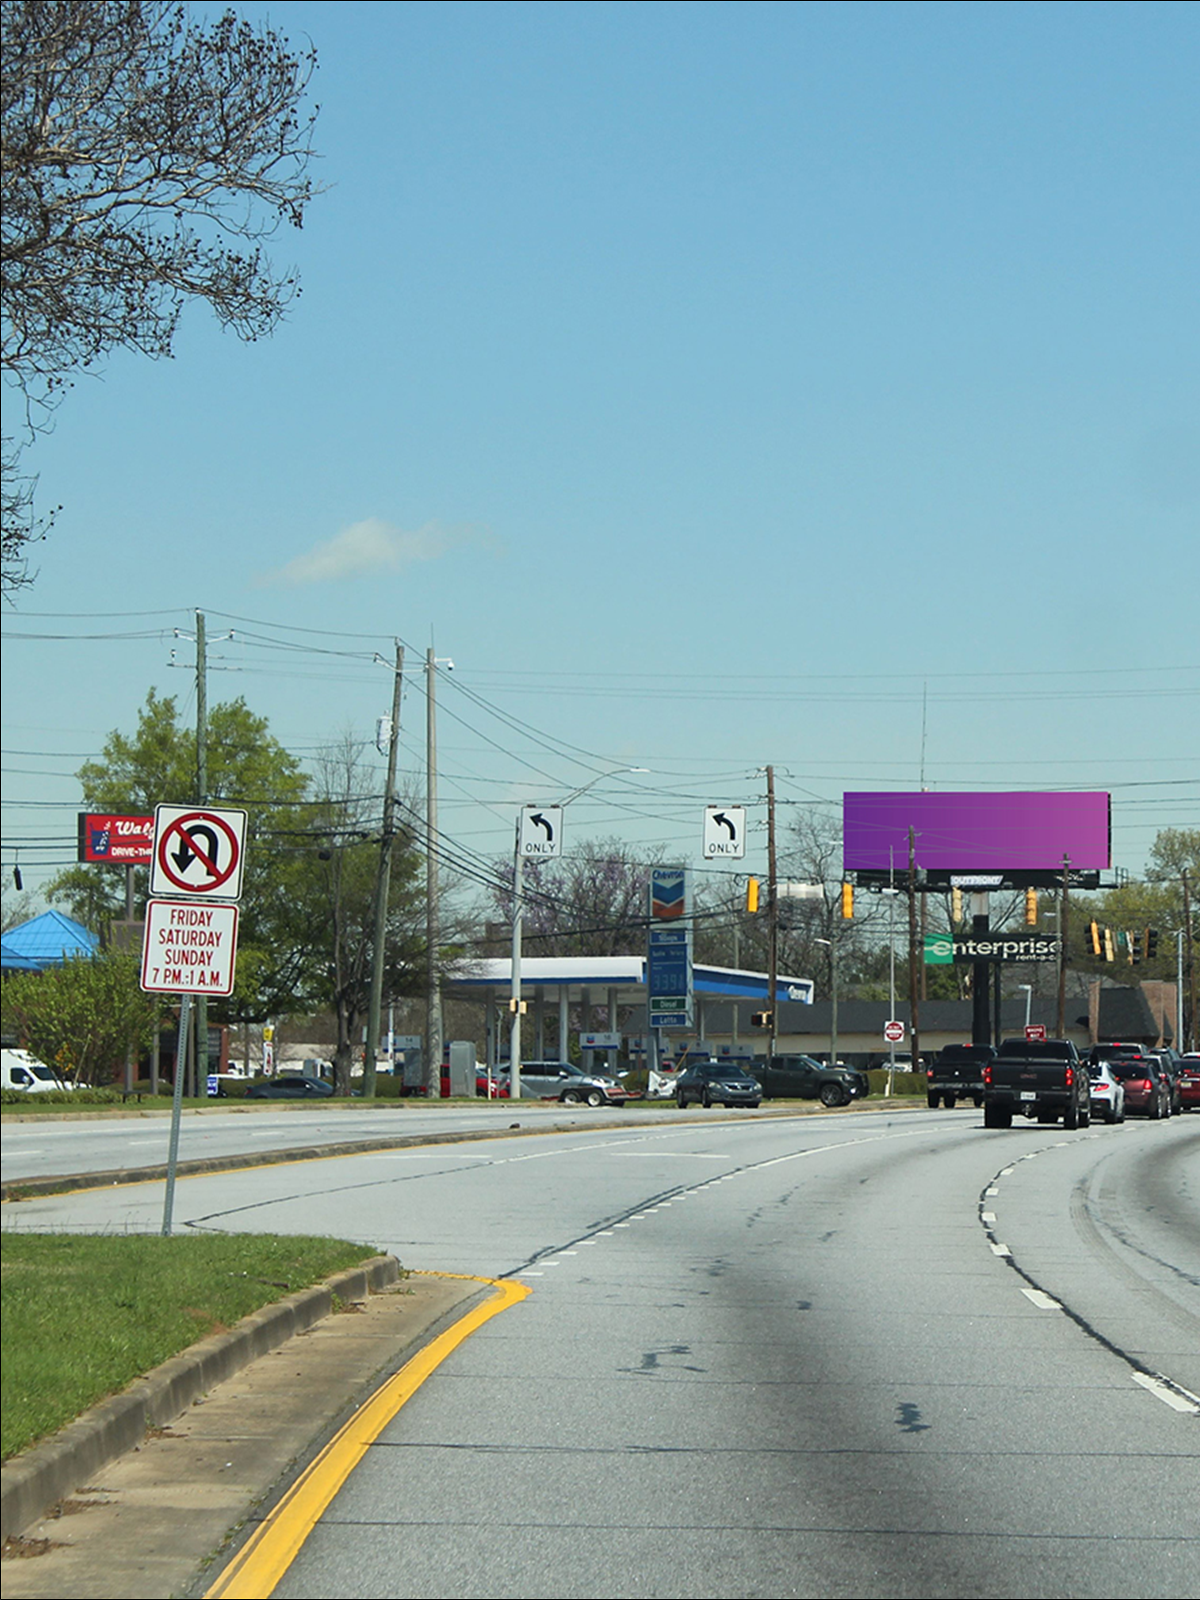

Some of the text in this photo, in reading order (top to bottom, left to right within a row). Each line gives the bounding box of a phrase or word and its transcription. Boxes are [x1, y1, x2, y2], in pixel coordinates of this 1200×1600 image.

[525, 843, 556, 853] ONLY
[708, 843, 739, 853] ONLY
[652, 869, 685, 880] Chevron
[170, 908, 213, 927] FRIDAY
[158, 928, 222, 947] SATURDAY
[165, 948, 214, 966] SUNDAY
[153, 967, 160, 983] 7
[198, 970, 223, 987] A.M.
